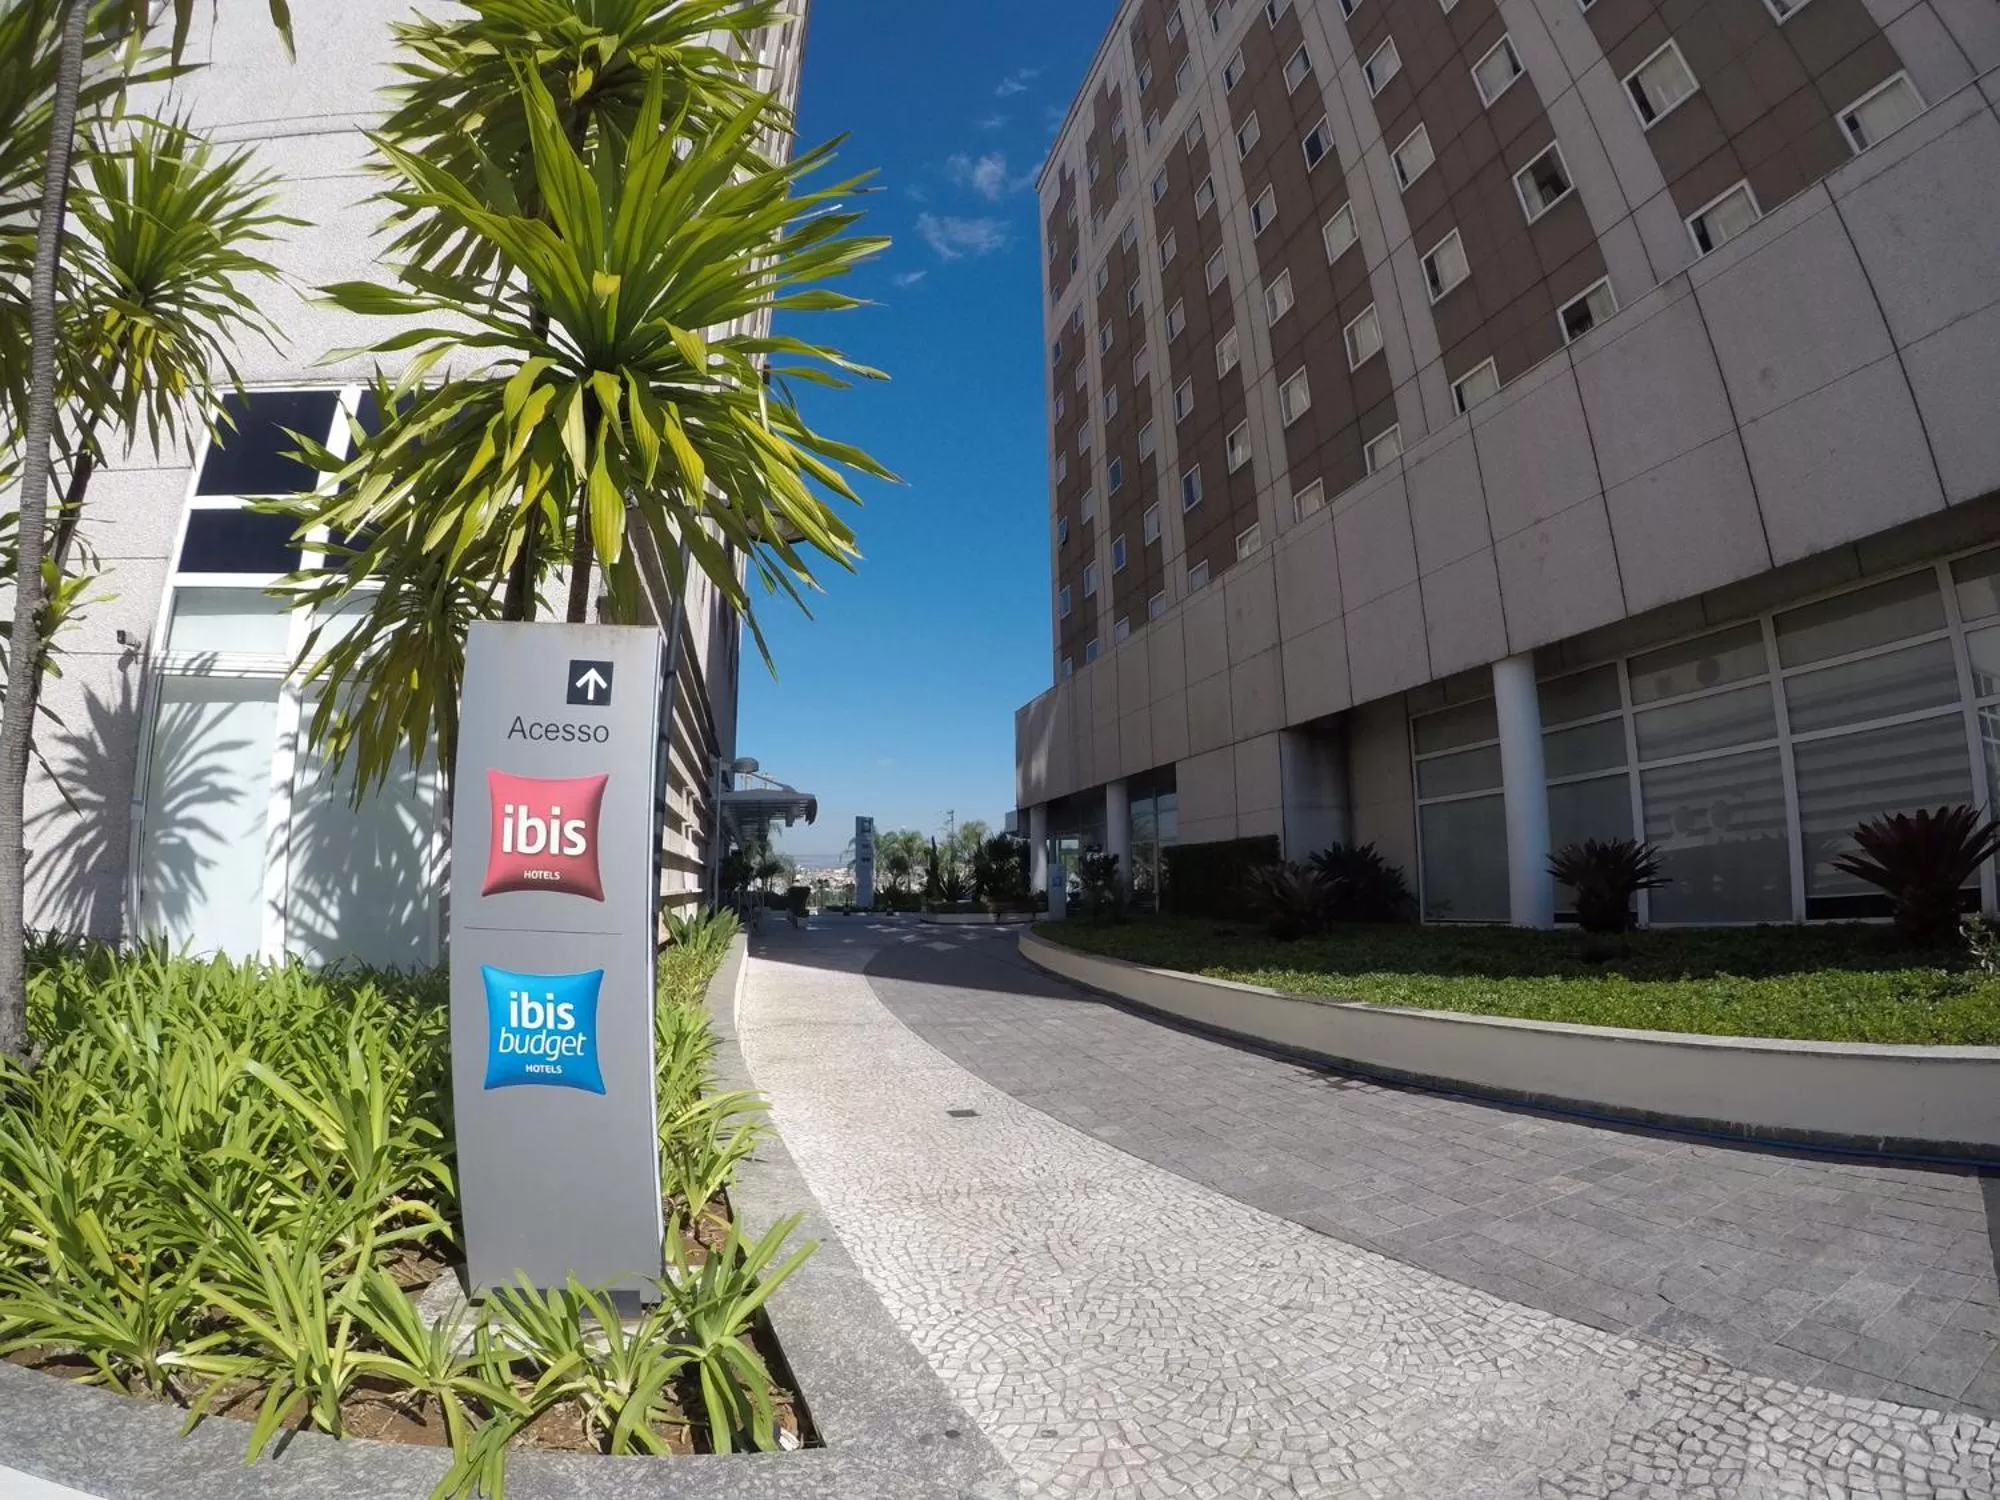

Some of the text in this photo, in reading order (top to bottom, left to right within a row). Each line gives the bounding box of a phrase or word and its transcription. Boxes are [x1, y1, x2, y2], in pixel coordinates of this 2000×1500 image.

[507, 716, 609, 743] Acesso
[502, 804, 587, 856] ibis
[523, 869, 561, 881] HOTELS
[509, 991, 576, 1031] ibis
[499, 1026, 587, 1062] budget
[525, 1063, 563, 1075] HOTELS
